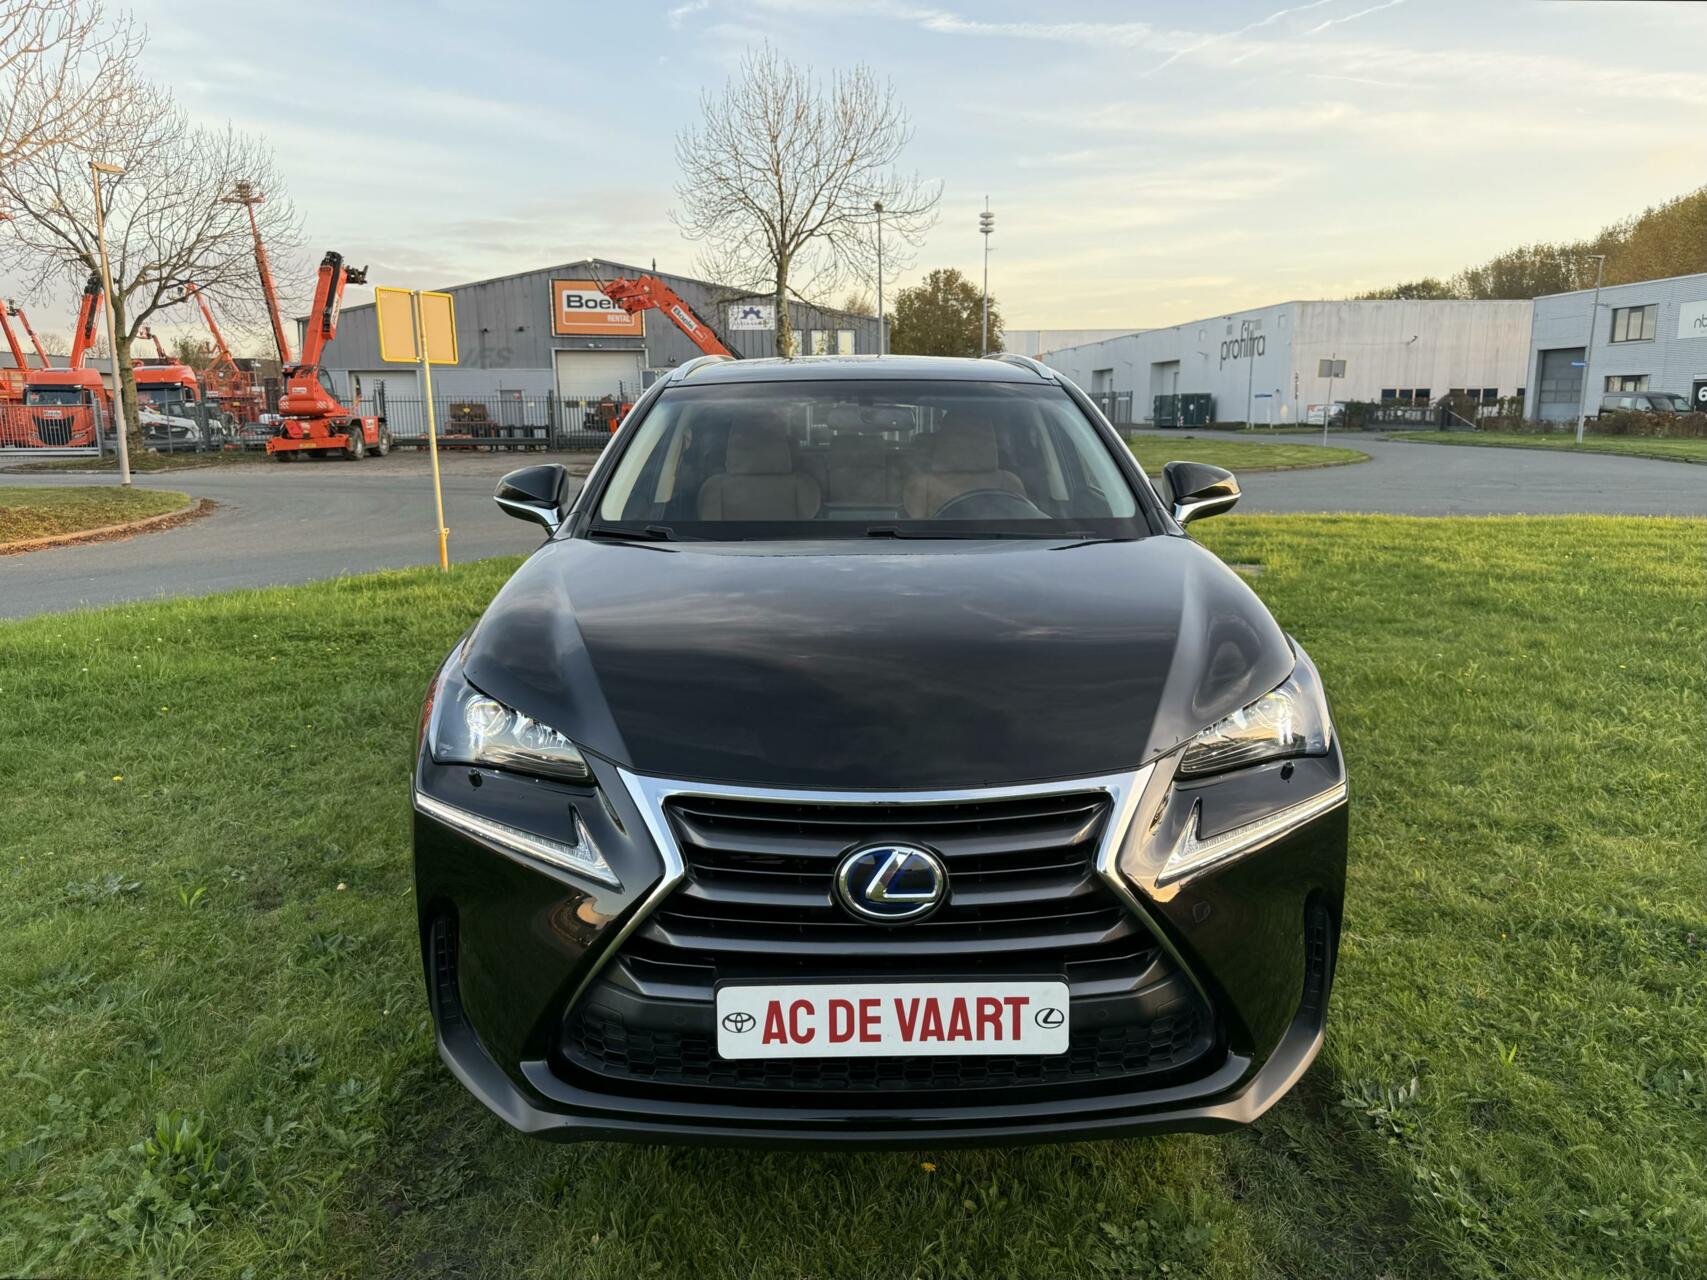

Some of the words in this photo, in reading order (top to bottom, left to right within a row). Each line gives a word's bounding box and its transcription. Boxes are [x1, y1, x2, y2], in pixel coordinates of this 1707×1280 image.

[1219, 320, 1266, 371] profiltra
[761, 1000, 816, 1044] AC
[828, 998, 882, 1043] DE
[894, 996, 1030, 1042] VAART
